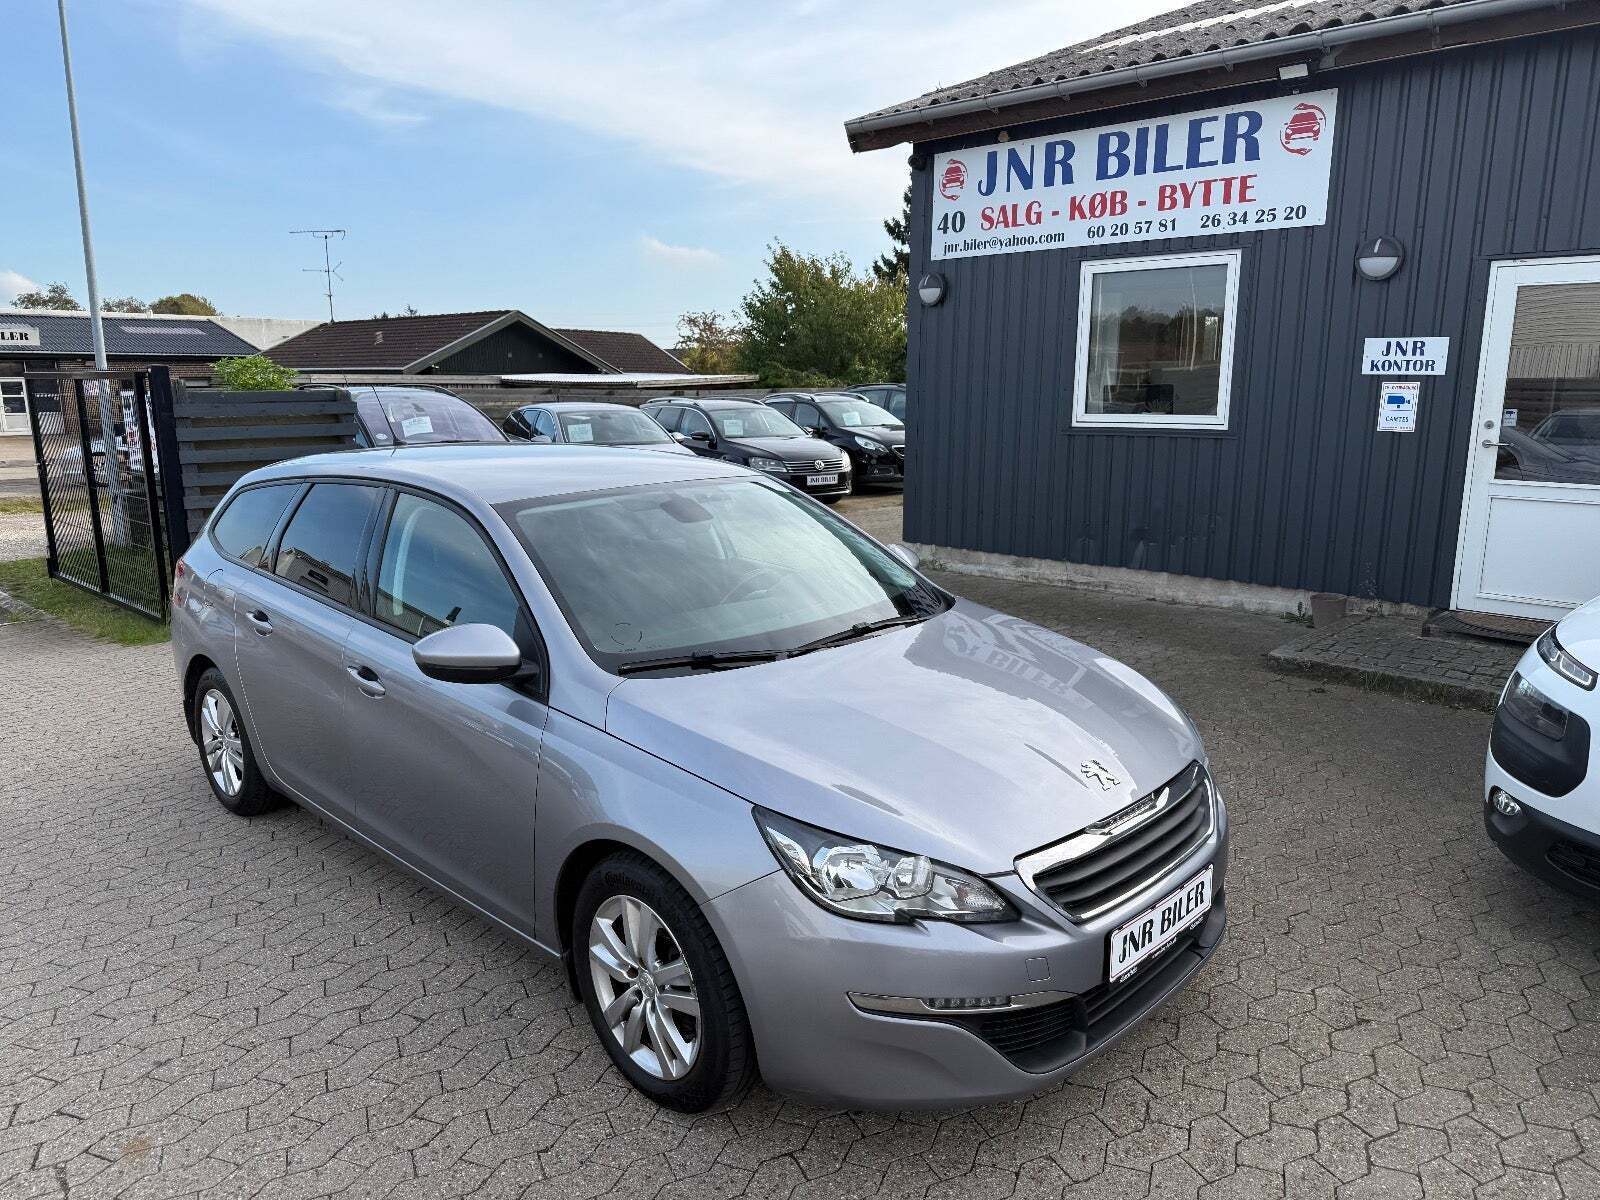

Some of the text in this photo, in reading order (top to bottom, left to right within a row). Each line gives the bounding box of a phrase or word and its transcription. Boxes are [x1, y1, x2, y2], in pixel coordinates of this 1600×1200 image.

[978, 110, 1263, 197] JNR BILER
[980, 200, 1042, 231] SALG
[1068, 190, 1128, 221] KØB
[1157, 174, 1258, 212] BYTTE
[937, 210, 966, 235] 40
[1087, 217, 1177, 239] 60 20 57 81
[1200, 204, 1307, 229] 26 34 25 20
[943, 231, 1065, 256] jnr.biler@yahoo.com
[0, 331, 30, 341] LER
[1381, 340, 1426, 357] JNR
[1369, 359, 1436, 372] KONTOR
[1118, 918, 1154, 964] JNR
[1160, 880, 1205, 937] BILER
